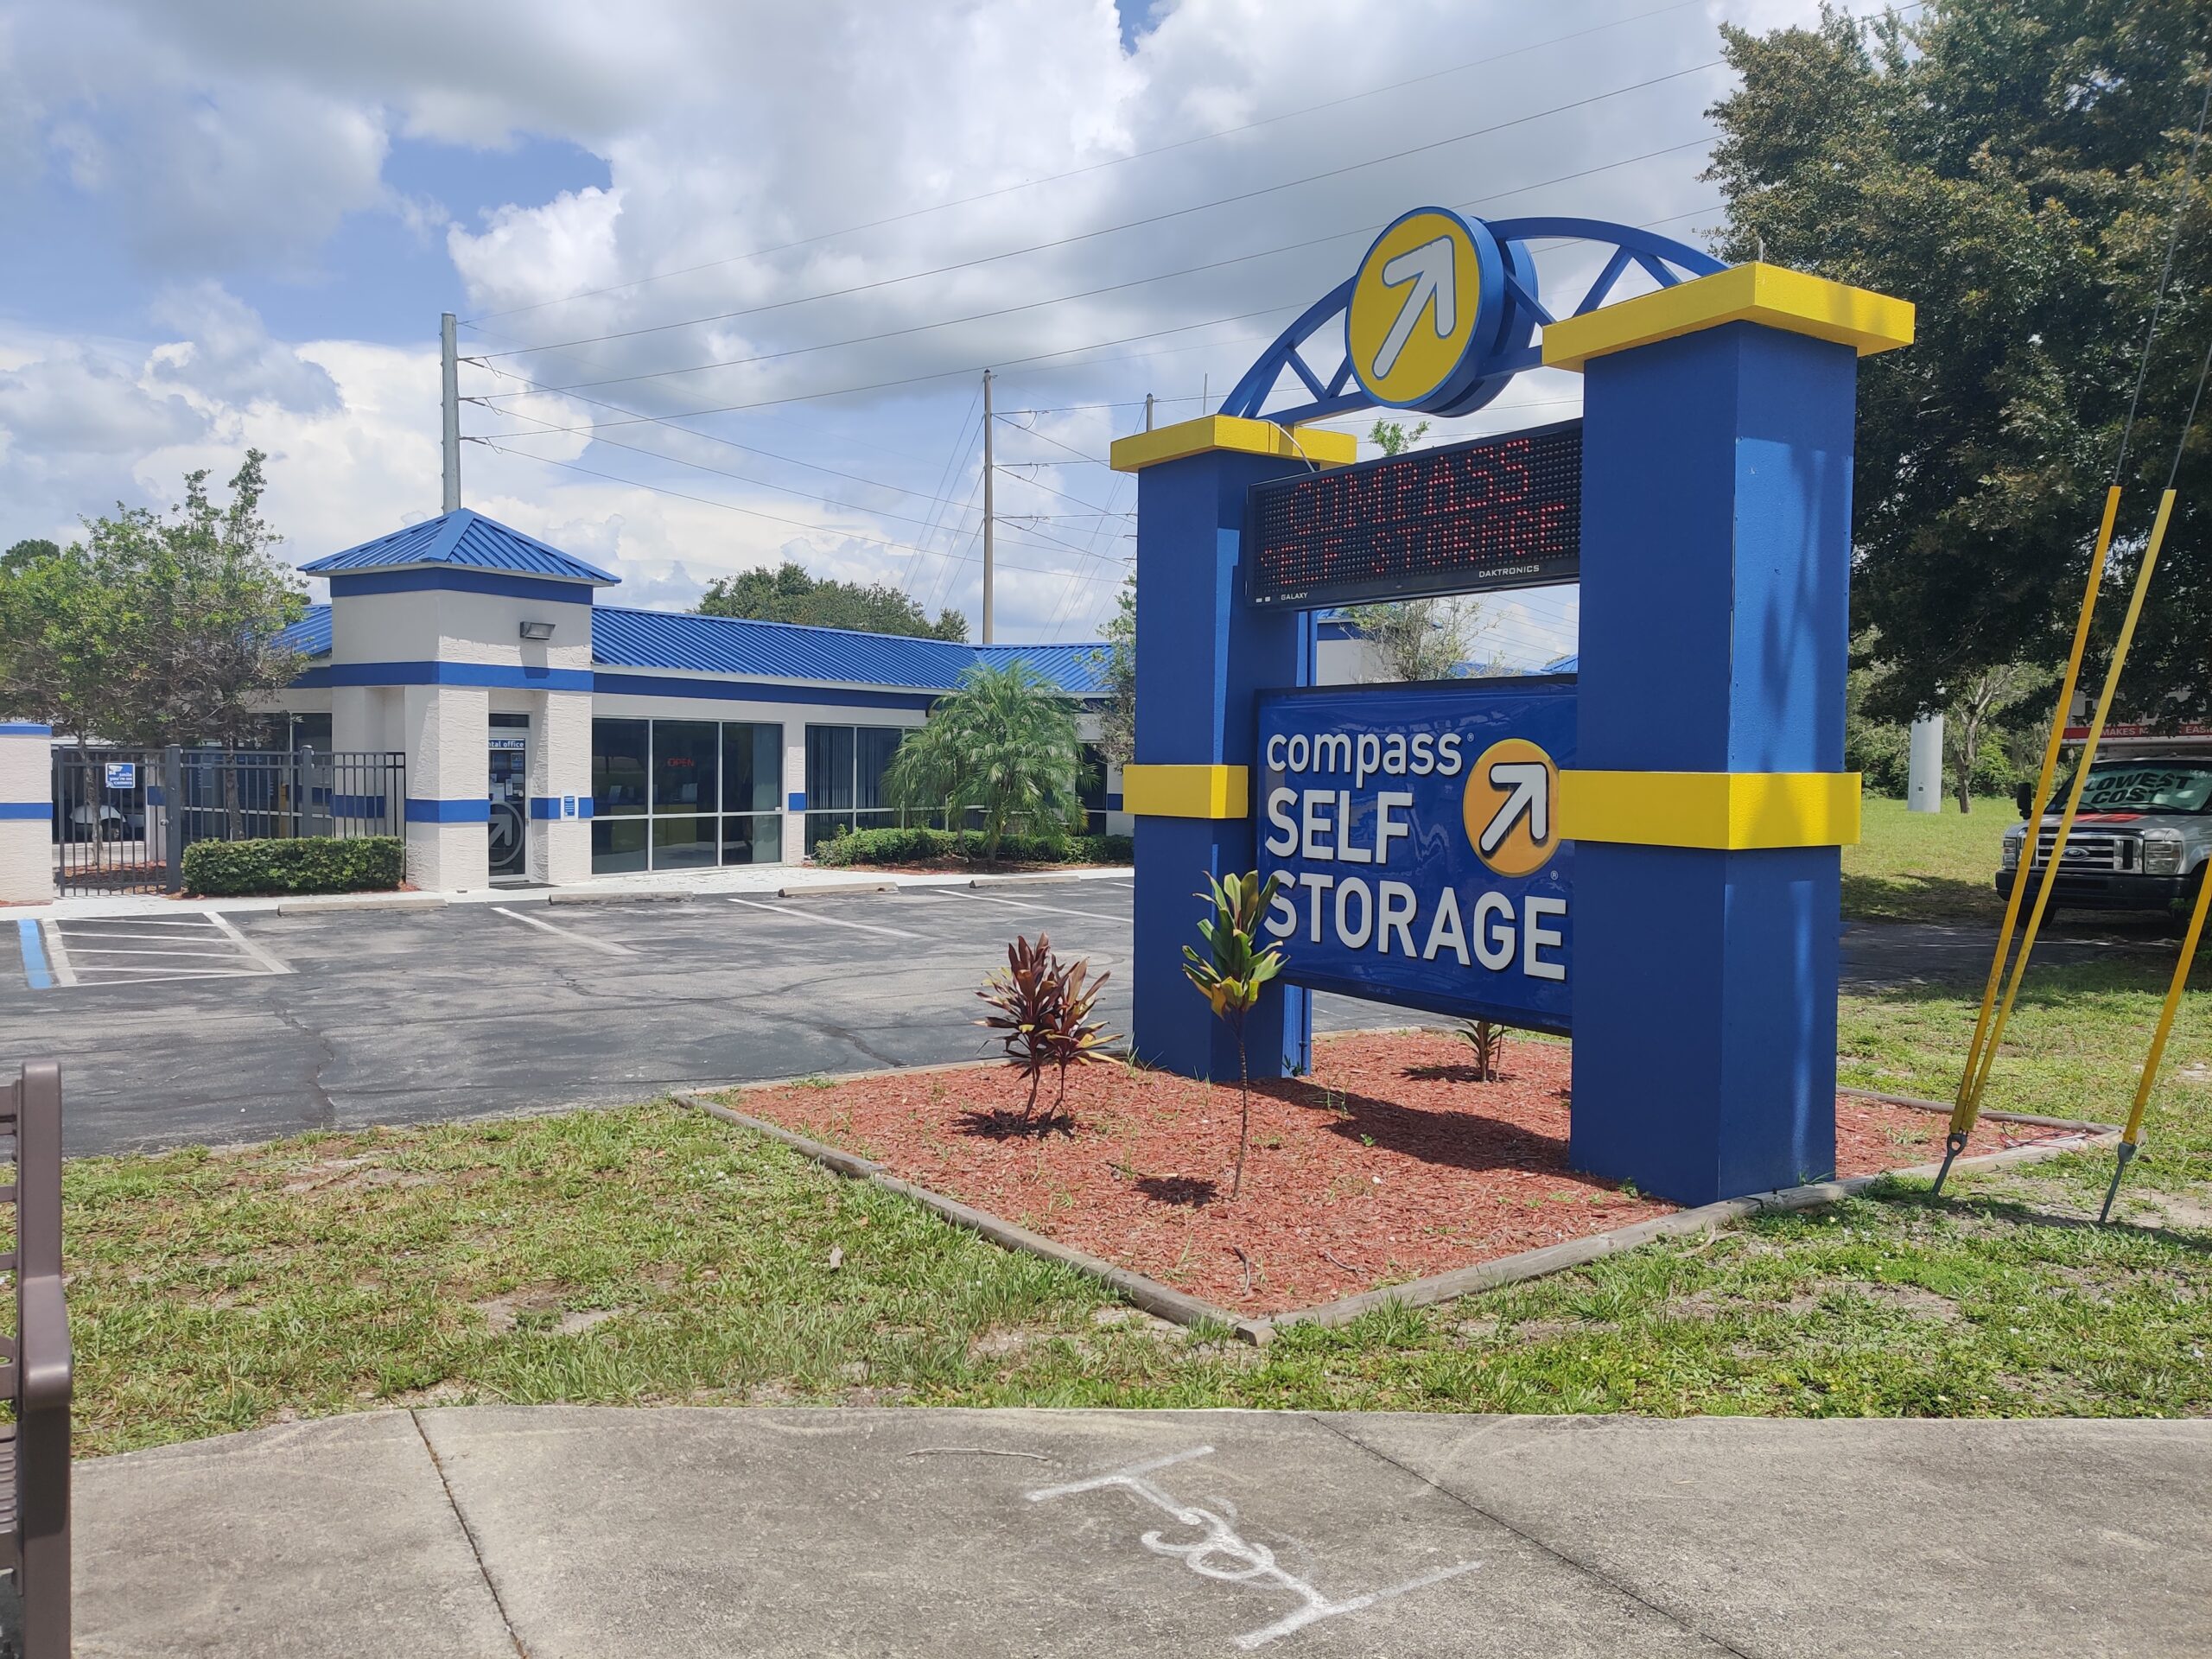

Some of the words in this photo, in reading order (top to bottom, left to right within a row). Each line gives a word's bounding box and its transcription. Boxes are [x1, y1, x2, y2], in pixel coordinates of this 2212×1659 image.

[1288, 439, 1531, 537] COMPASS
[1370, 505, 1567, 576] STORAGE
[1478, 564, 1540, 578] DAKTRONICS
[1281, 591, 1308, 601] GALAXY
[2101, 728, 2136, 737] MAKES
[667, 758, 695, 767] OPEN
[1267, 733, 1462, 788] compass
[2083, 772, 2195, 792] LOWEST
[2091, 787, 2164, 804] COST
[1265, 786, 1413, 864] SELF
[1263, 869, 1567, 981] STORAGE
